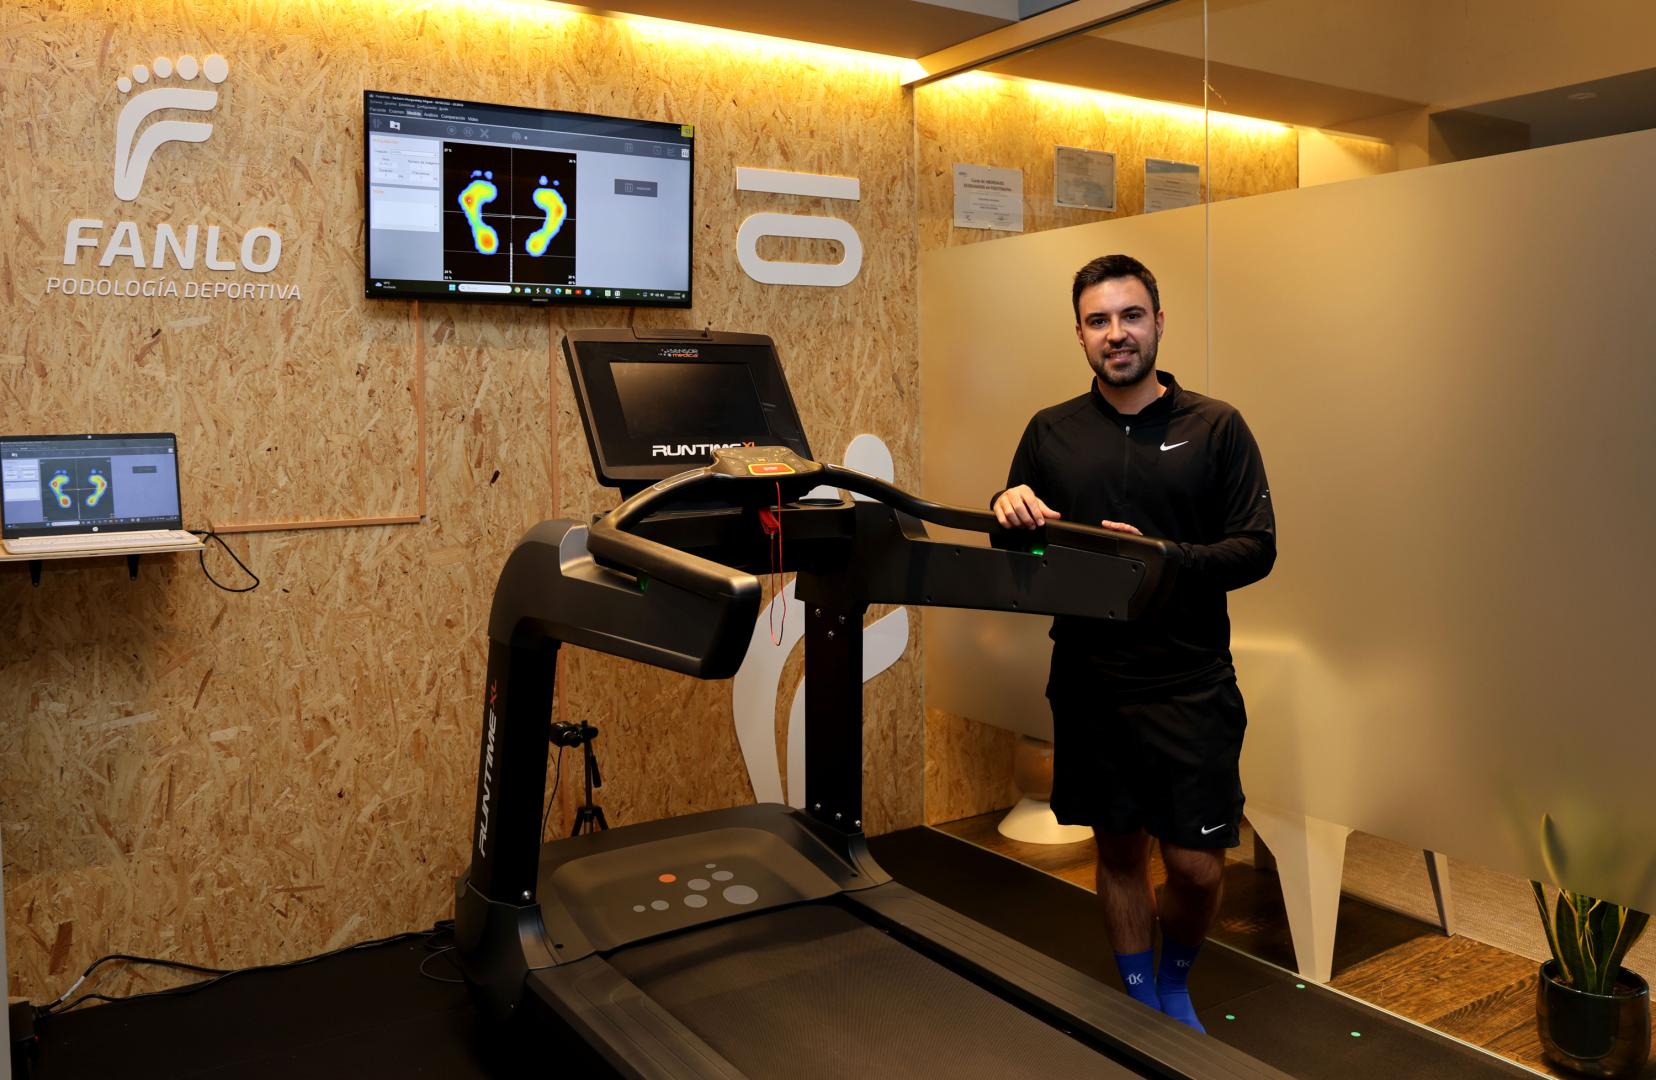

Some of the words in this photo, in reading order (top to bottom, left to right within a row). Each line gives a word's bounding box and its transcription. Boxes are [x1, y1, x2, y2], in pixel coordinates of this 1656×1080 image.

[63, 218, 282, 273] FANLO
[46, 277, 177, 298] PODOLOGÍA
[184, 281, 301, 301] DEPORTIVA
[478, 708, 497, 858] RUNTIME
[489, 680, 497, 708] XL
